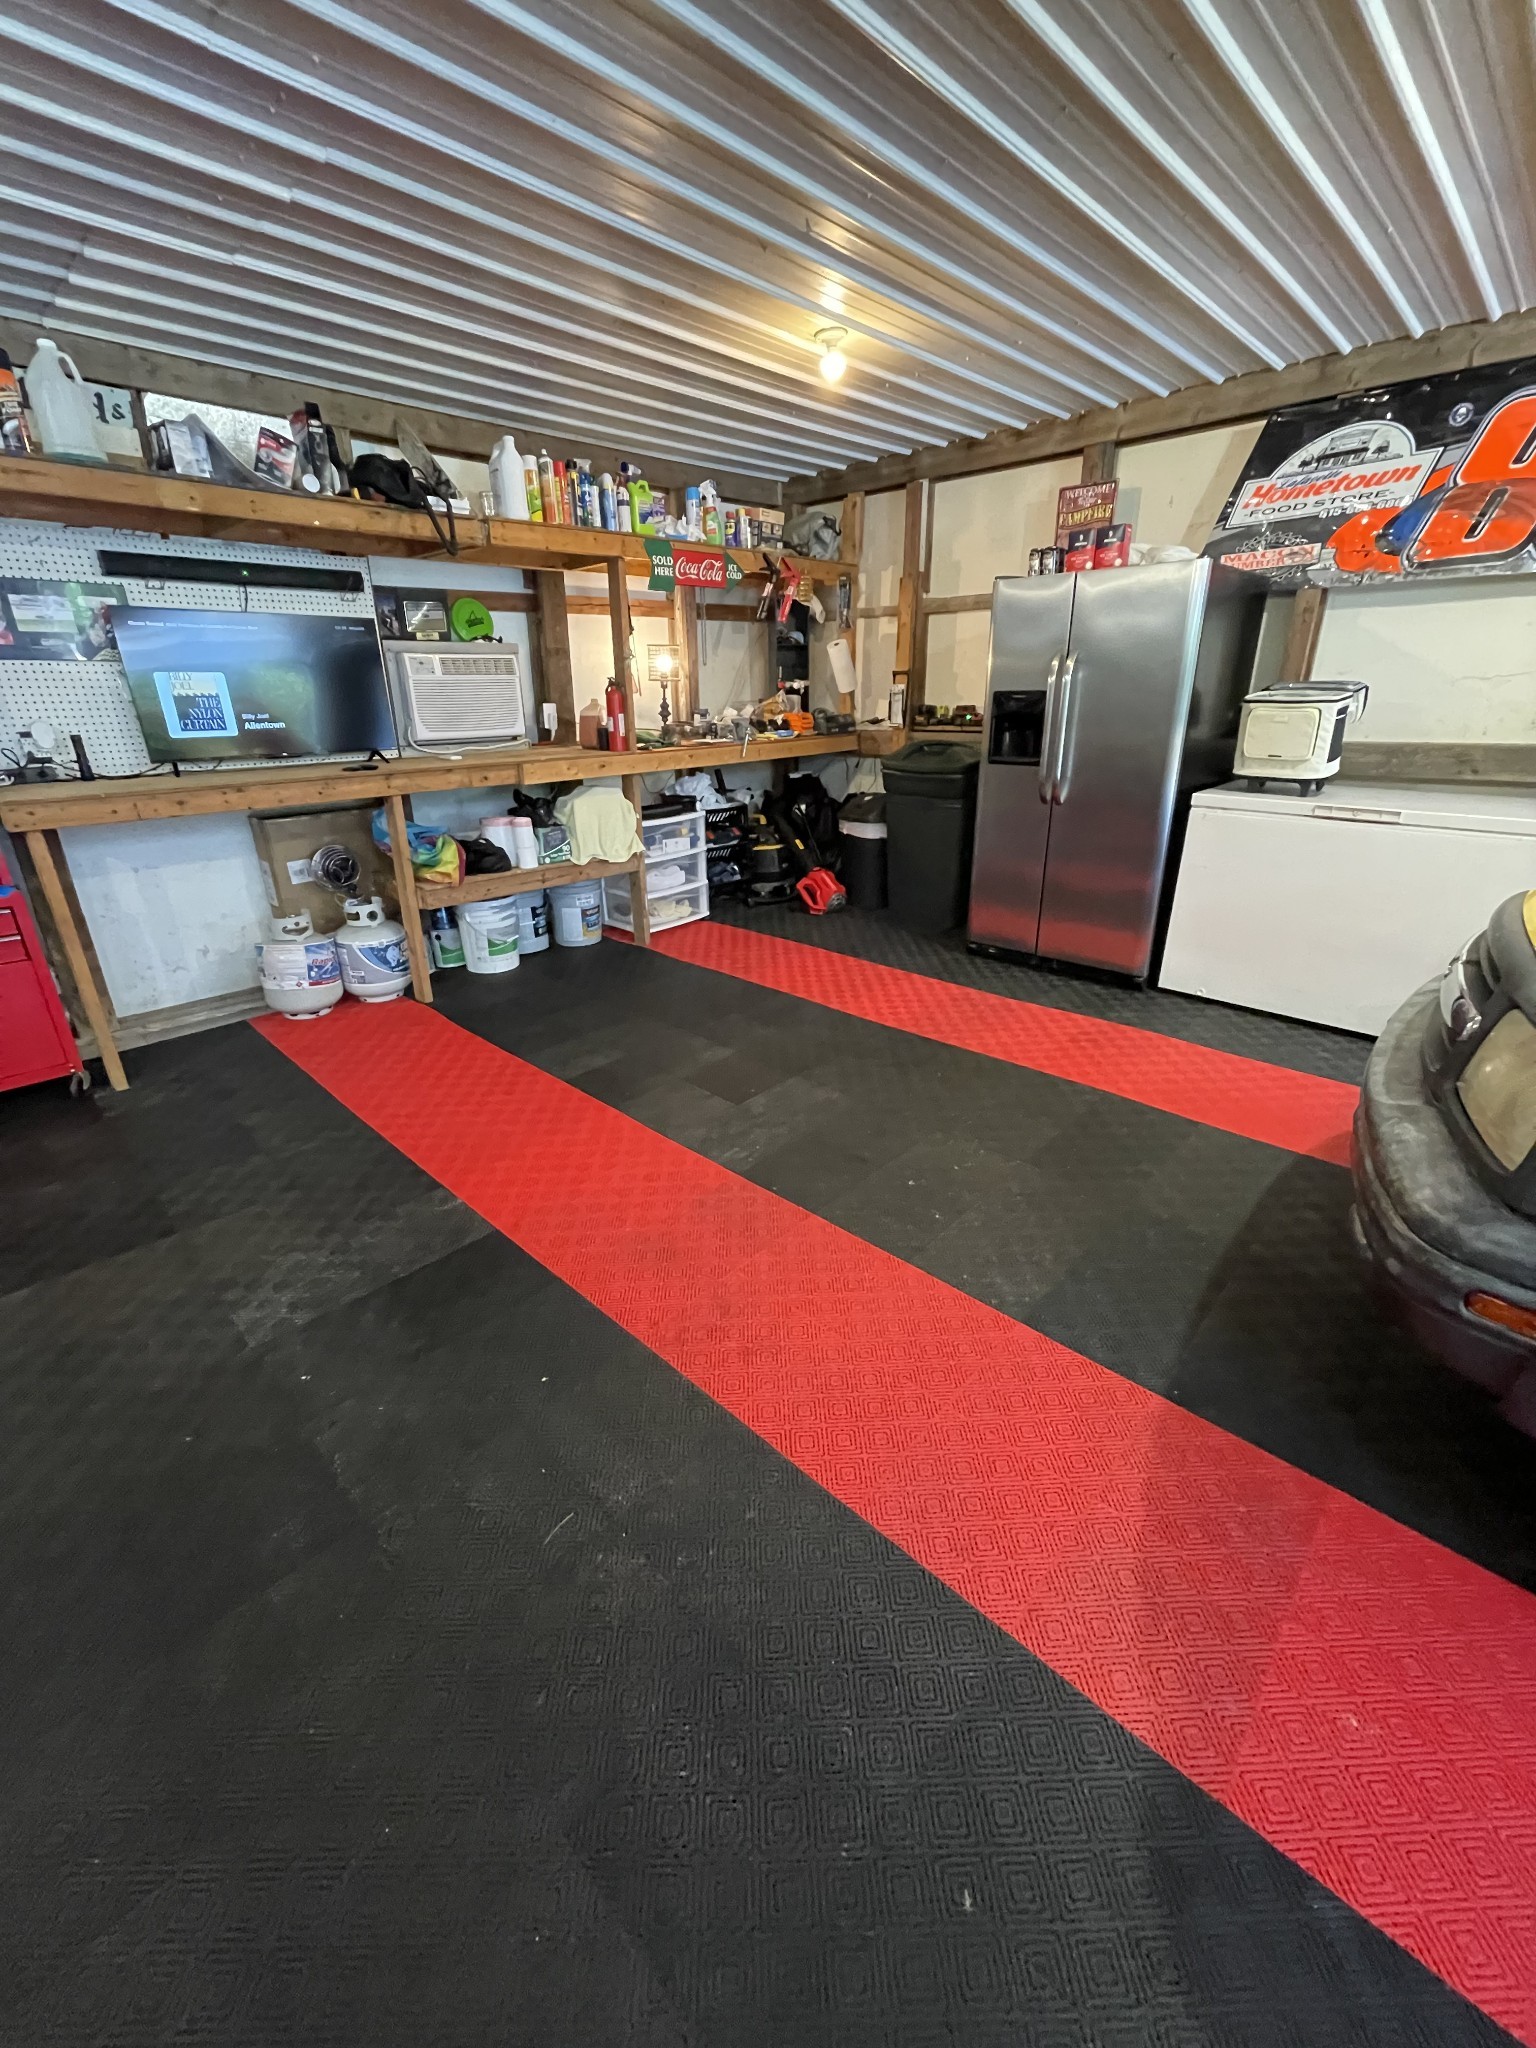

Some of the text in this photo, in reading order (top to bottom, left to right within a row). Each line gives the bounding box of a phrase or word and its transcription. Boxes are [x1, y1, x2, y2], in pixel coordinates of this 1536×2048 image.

[1066, 484, 1111, 499] WELCOME
[1241, 464, 1423, 510] Hometown
[1060, 504, 1113, 526] CAMPFIRE
[652, 555, 673, 566] SOLD
[655, 566, 674, 576] HERE
[675, 557, 723, 582] Coca-Cola
[728, 564, 737, 572] ICE
[726, 571, 742, 580] COLD
[195, 697, 221, 708] THE
[188, 708, 223, 719] NYLON
[180, 719, 226, 730] CURTAIN
[244, 721, 286, 730] Allentown
